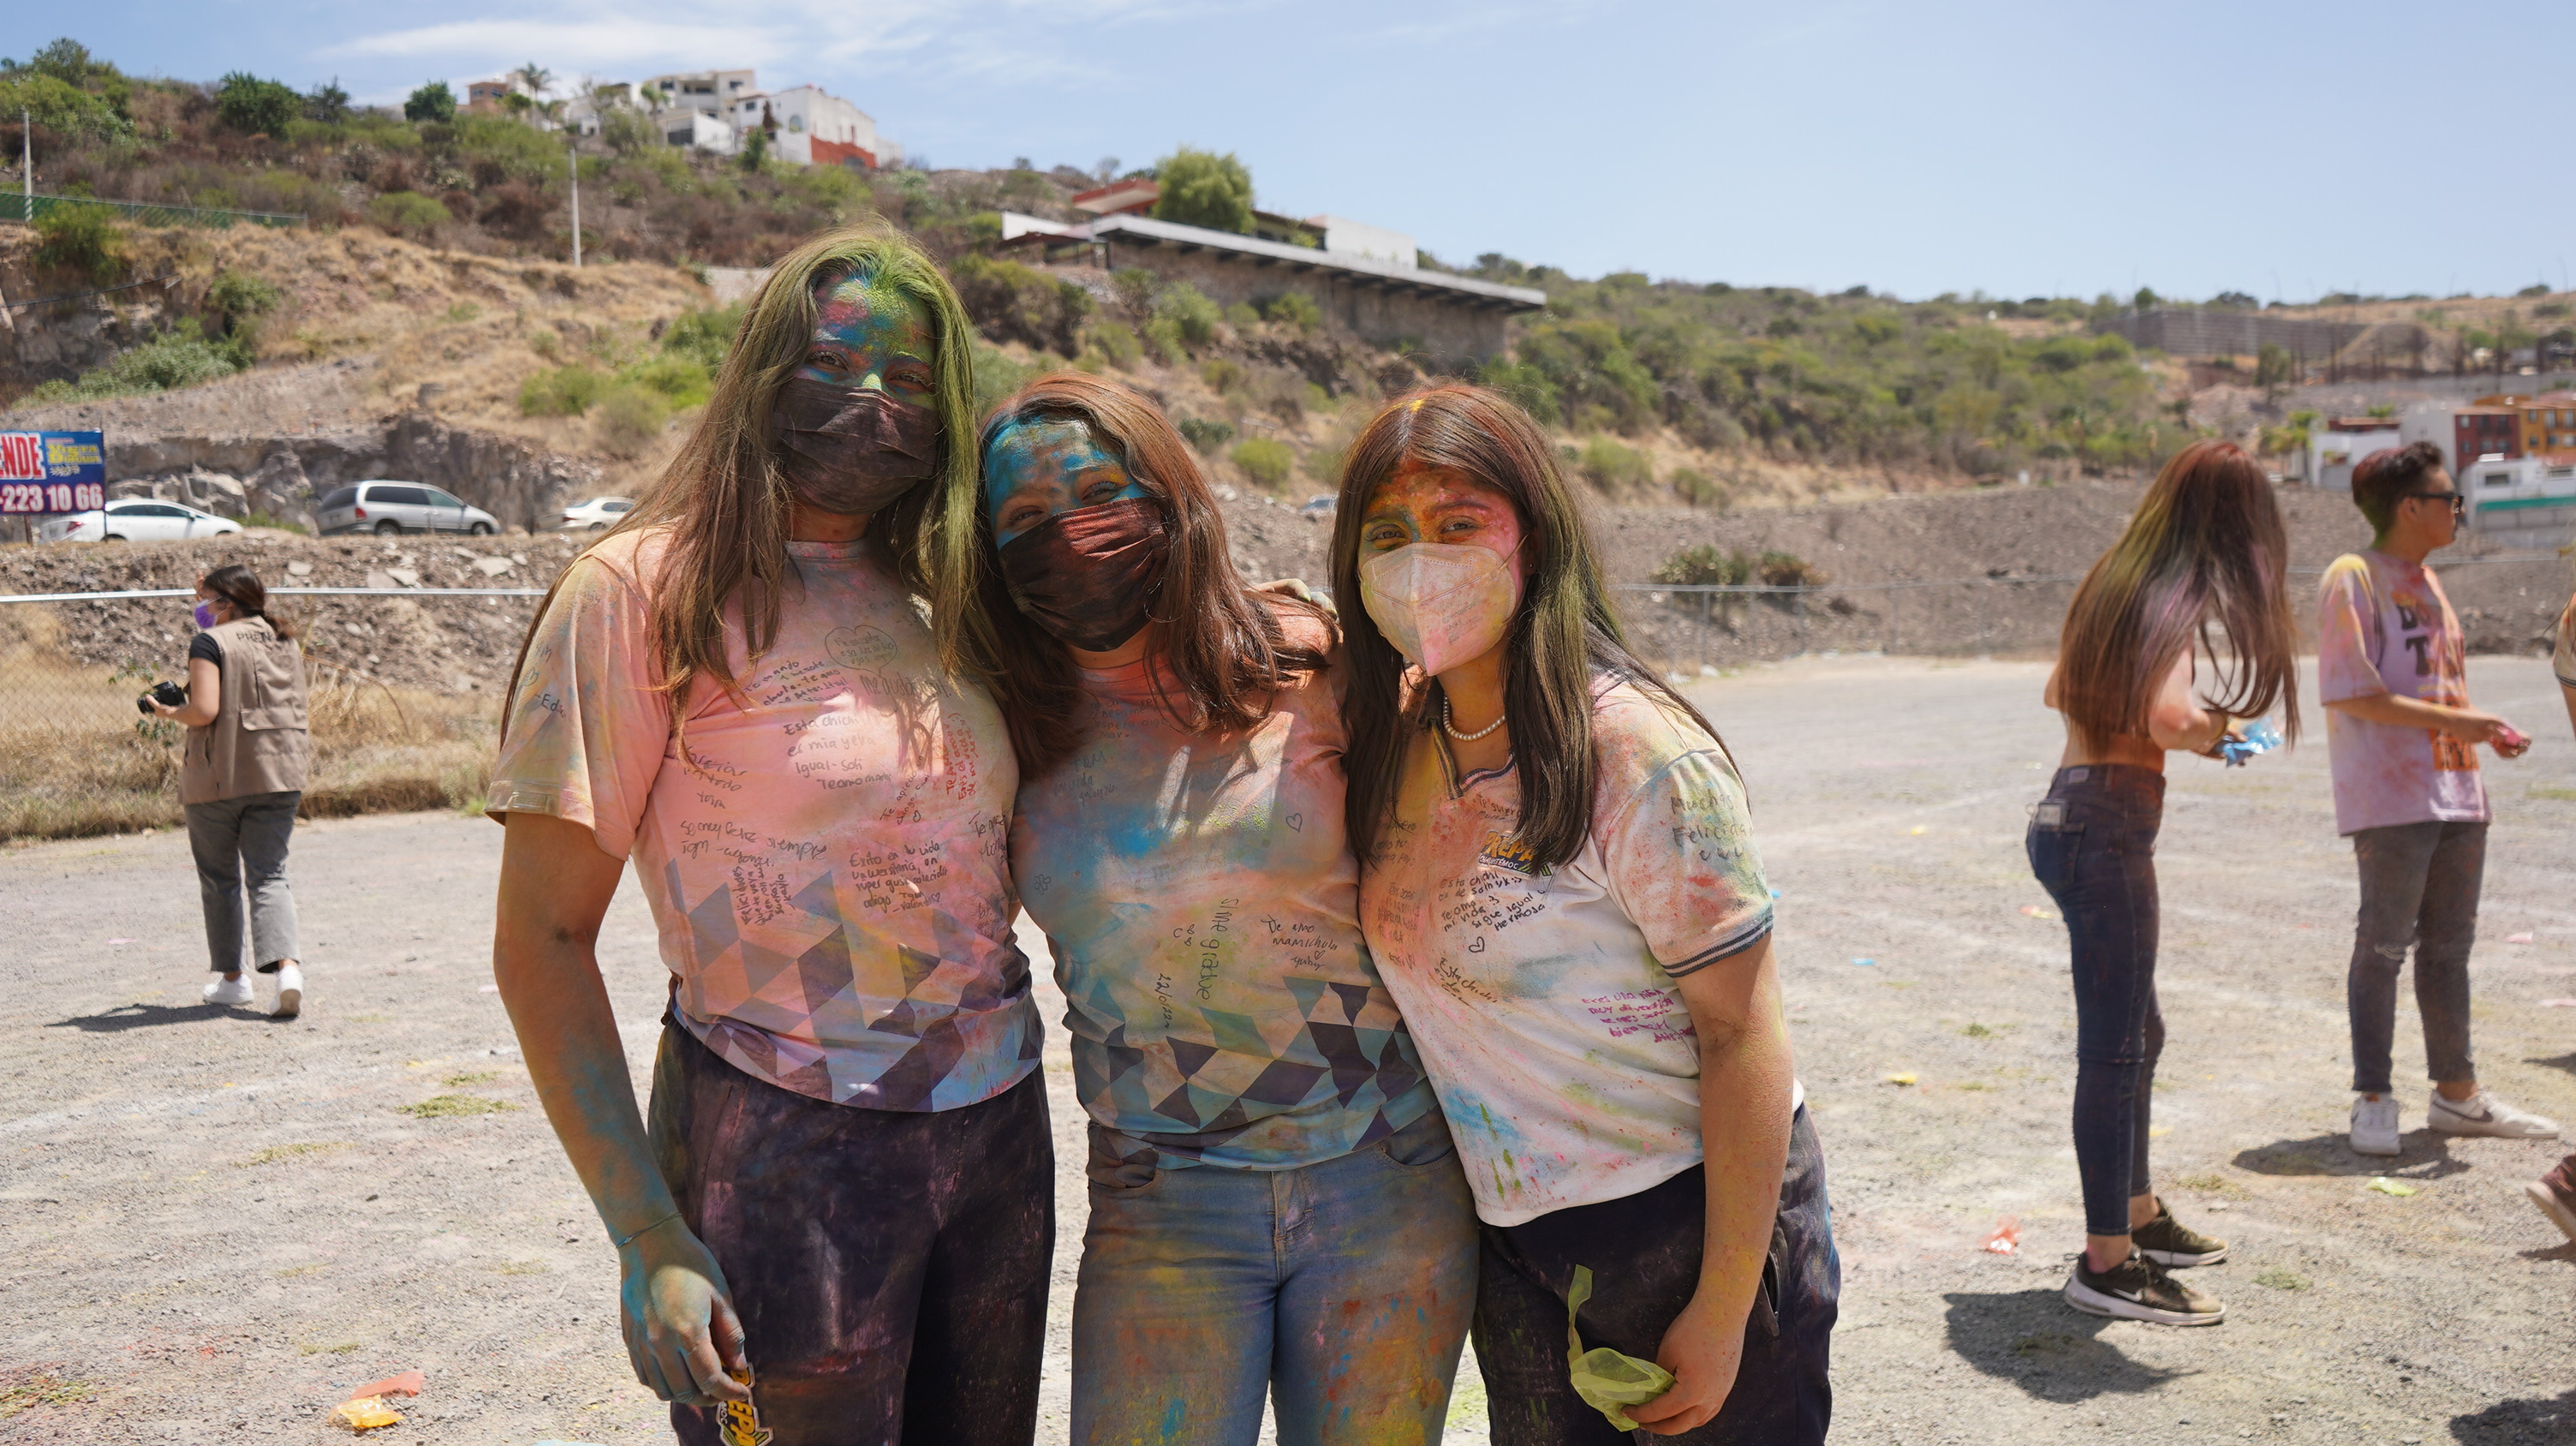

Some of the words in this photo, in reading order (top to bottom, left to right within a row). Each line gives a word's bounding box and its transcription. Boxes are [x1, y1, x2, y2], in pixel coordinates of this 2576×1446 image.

[0, 433, 43, 478] NDE
[46, 484, 73, 512] 10
[75, 482, 104, 511] 66
[783, 719, 819, 736] Esta
